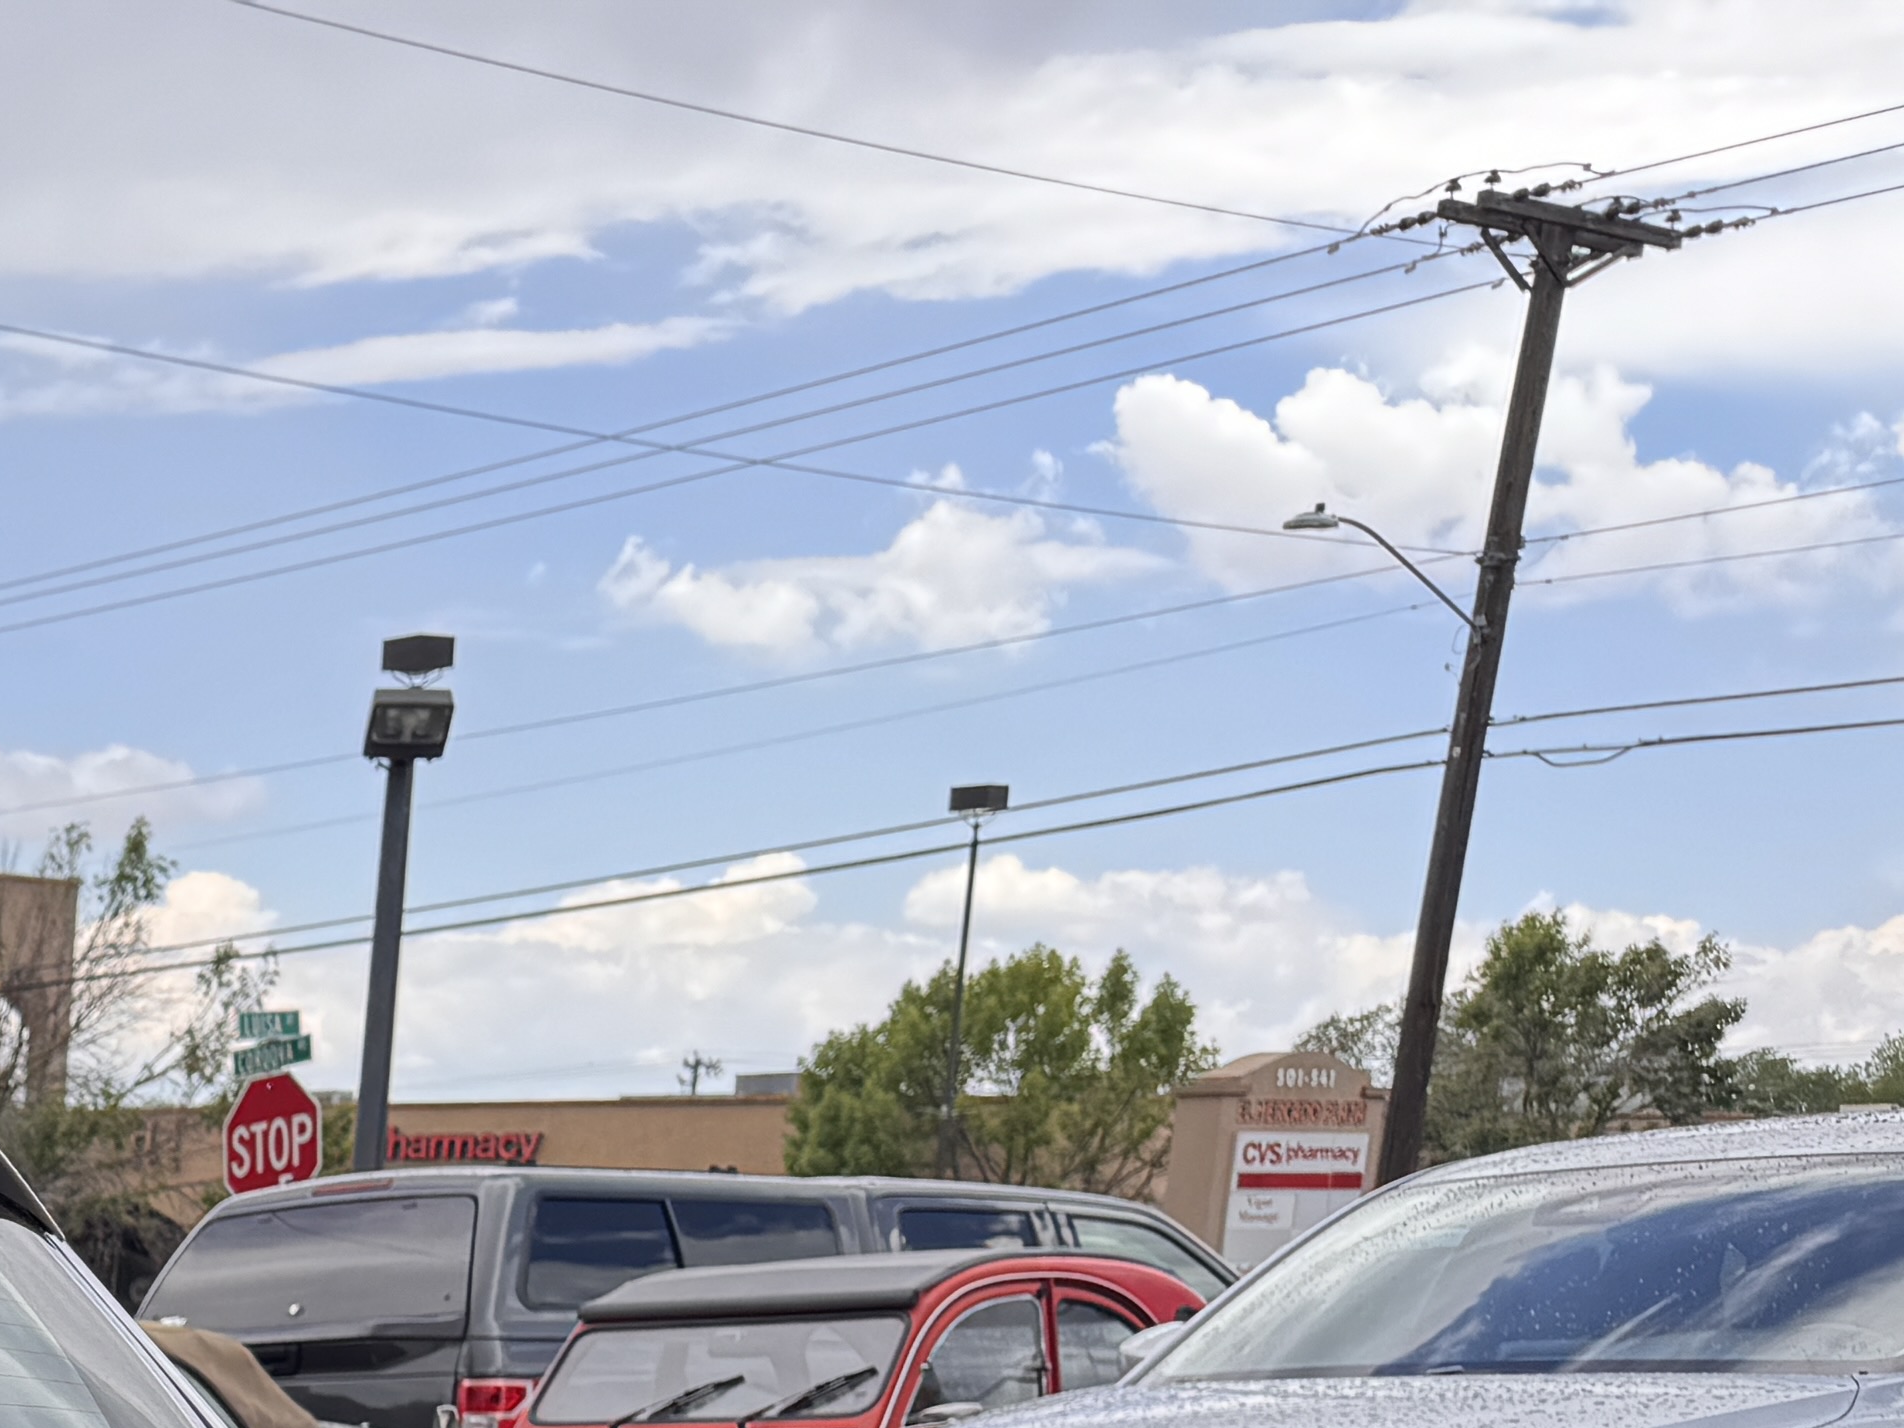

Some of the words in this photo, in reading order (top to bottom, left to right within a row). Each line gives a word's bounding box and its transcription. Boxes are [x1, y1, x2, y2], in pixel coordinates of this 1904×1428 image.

[230, 1112, 313, 1179] STOP
[386, 1124, 543, 1164] harmacy
[1243, 1141, 1282, 1165] CVS
[1286, 1140, 1361, 1167] pharmacy
